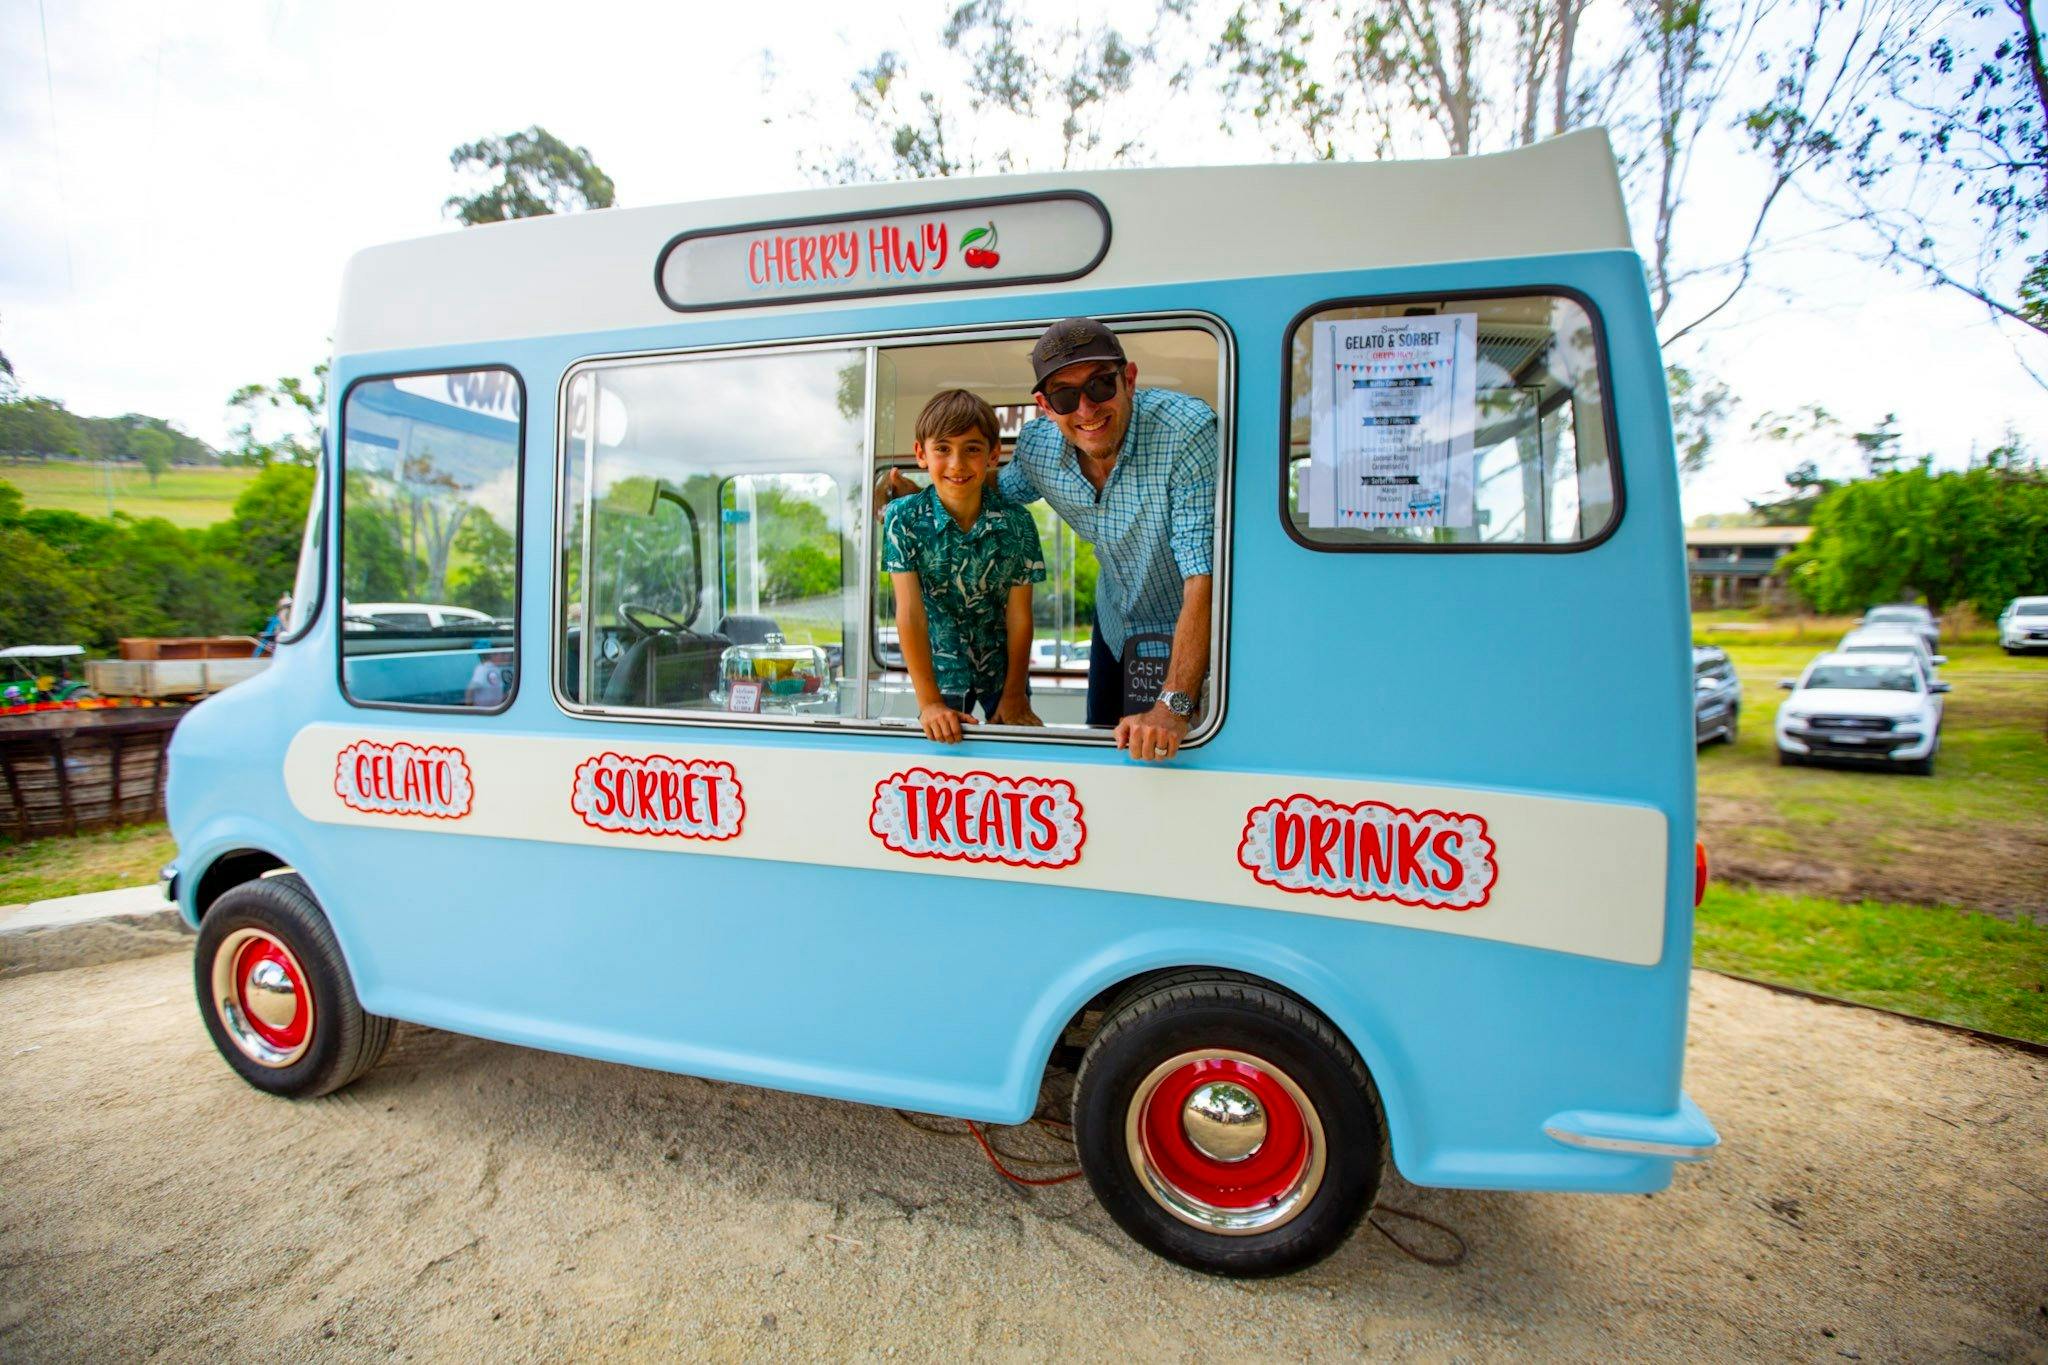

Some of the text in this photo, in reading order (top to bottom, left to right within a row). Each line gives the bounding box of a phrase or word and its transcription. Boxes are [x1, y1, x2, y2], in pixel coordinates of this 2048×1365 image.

[747, 222, 949, 286] CHERRY HWY
[1345, 332, 1440, 350] GELATO & SORBET
[1128, 660, 1164, 676] CASH
[354, 753, 453, 806] GELATO
[593, 767, 723, 828] SORBET
[899, 785, 1059, 852] TREATS
[1273, 811, 1464, 892] DRINKS
